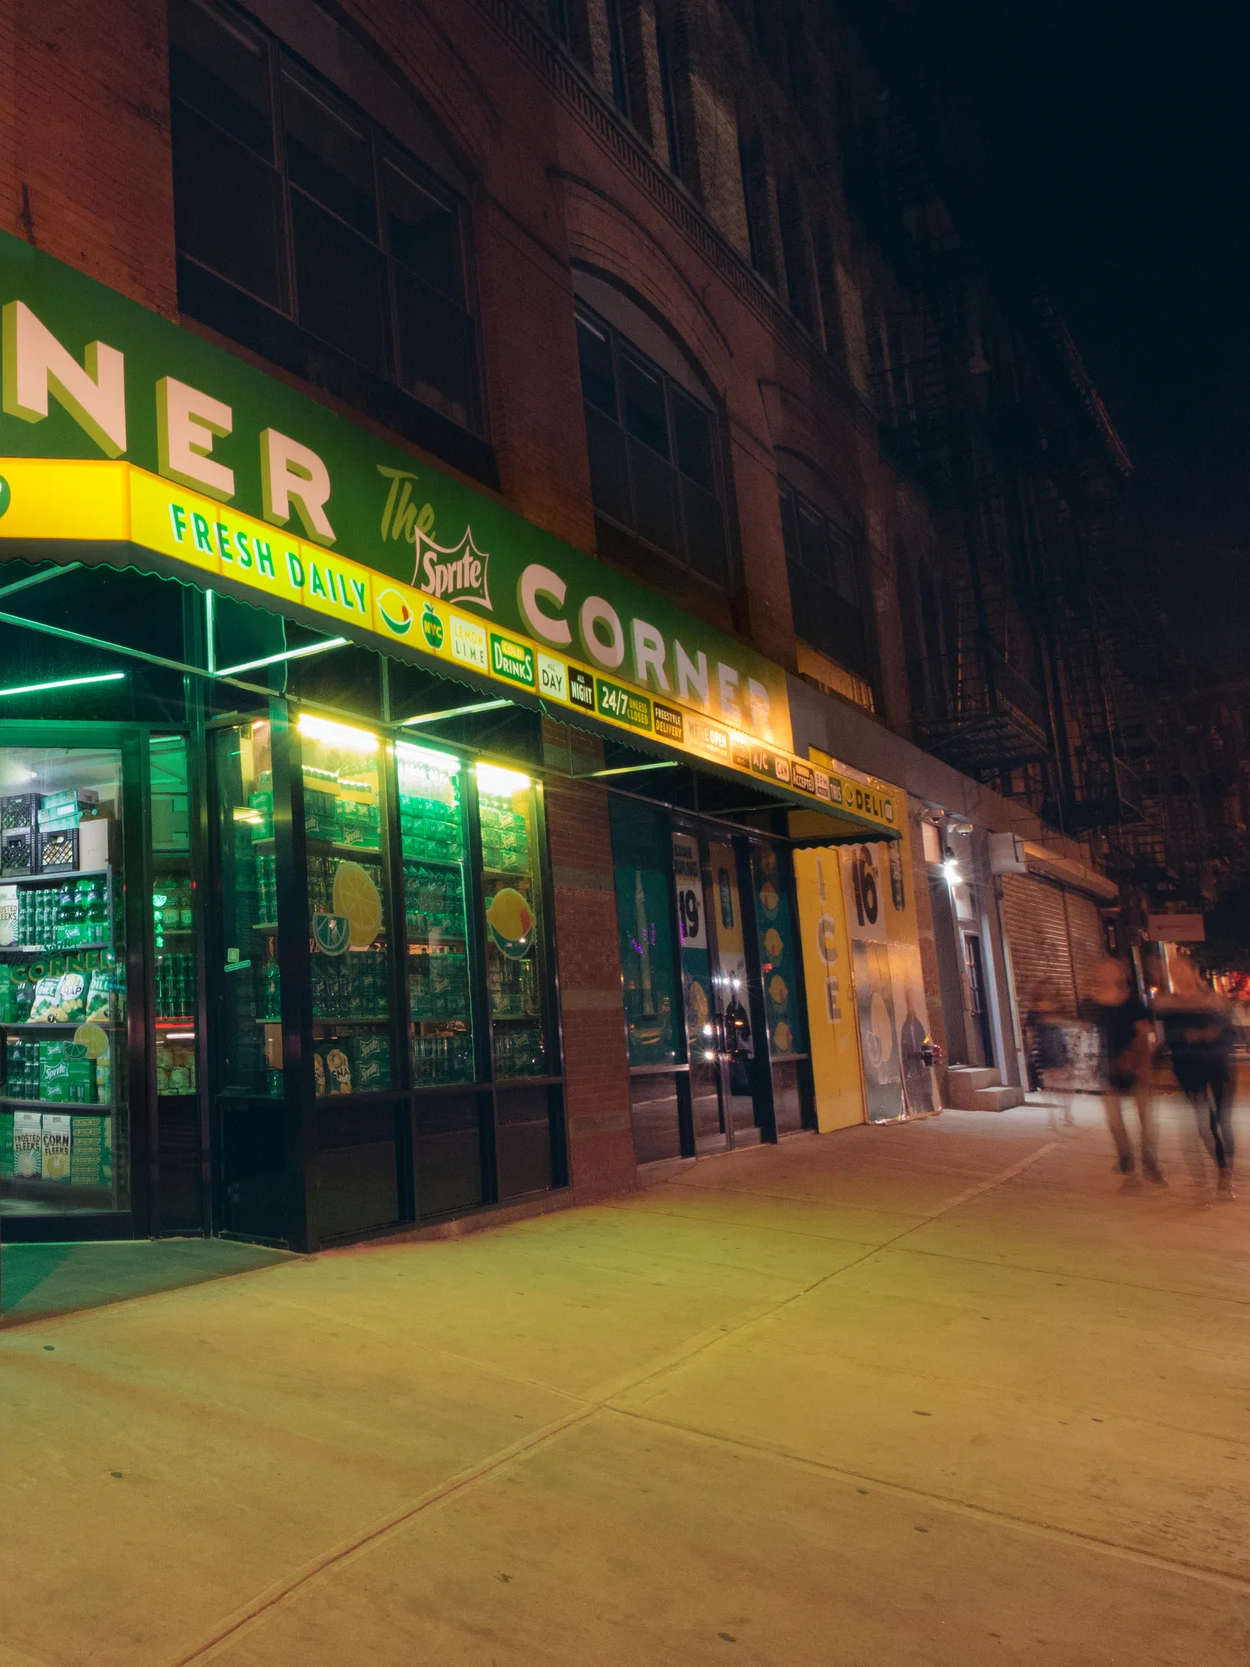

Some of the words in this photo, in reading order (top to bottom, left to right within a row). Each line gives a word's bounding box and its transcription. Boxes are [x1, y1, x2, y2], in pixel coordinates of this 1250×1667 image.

[376, 464, 436, 544] The
[168, 503, 276, 579] FRESH
[284, 551, 367, 613] DAILY
[420, 545, 482, 597] Sprite
[423, 619, 443, 639] NYC
[454, 623, 483, 646] LEMON
[455, 640, 485, 664] LIME
[494, 641, 533, 682] DRINKS
[502, 641, 524, 659] COLD
[517, 563, 774, 742] CORNER
[542, 669, 563, 693] DAY
[576, 674, 586, 684] ALL
[570, 680, 593, 705] NIGHT
[601, 686, 629, 715] 24/7
[627, 708, 649, 725] CLOSED
[629, 699, 648, 714] UNLESS
[655, 707, 682, 726] FREESTYLE
[655, 719, 682, 738] DELIVERY
[710, 729, 727, 748] OPEN
[855, 788, 883, 819] DELI
[851, 846, 878, 927] 16
[680, 889, 700, 939] 19
[815, 853, 843, 1024] ICE
[10, 949, 116, 984] CORNER
[45, 1064, 67, 1080] Sprite
[332, 1067, 350, 1081] SNA
[14, 1134, 41, 1144] FROSTED
[15, 1142, 40, 1152] FLEEKS
[43, 1135, 69, 1148] CORN
[45, 1147, 69, 1156] FLEEKS
